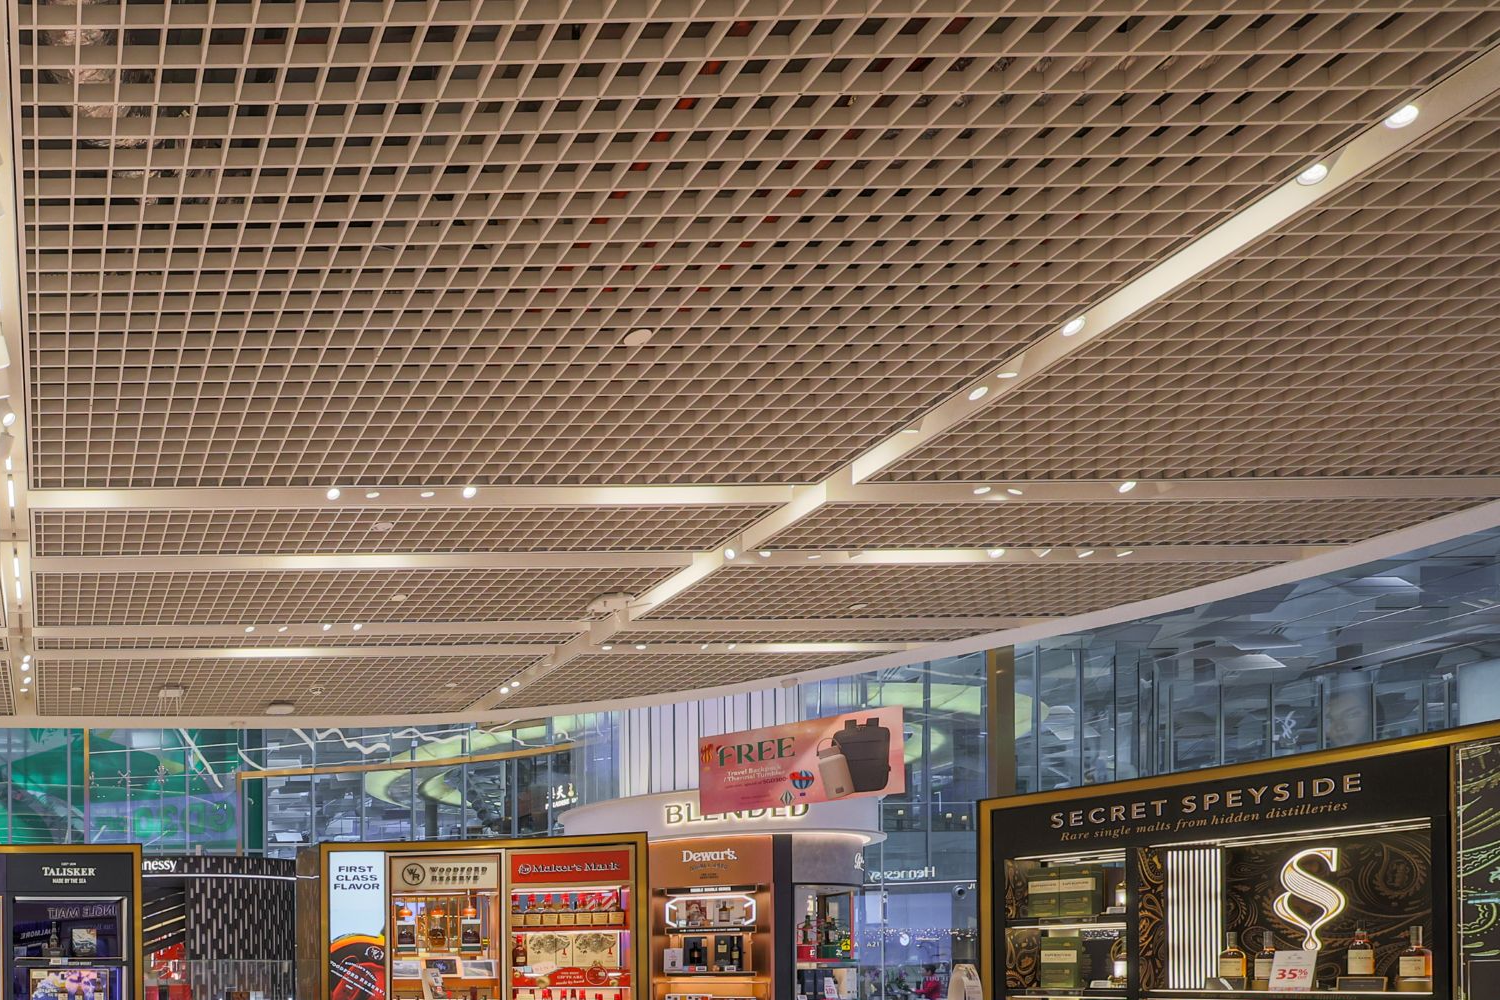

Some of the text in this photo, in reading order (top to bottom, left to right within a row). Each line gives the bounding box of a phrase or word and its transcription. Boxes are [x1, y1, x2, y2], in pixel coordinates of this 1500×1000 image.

[717, 736, 795, 767] FREE
[727, 765, 782, 776] Travel Backpack
[727, 774, 756, 782] Thermal
[1050, 773, 1363, 829] SECRET SPEYSIDE
[1060, 799, 1348, 841] Rare single malts from hidden distilleries
[42, 866, 96, 877] TALISKER
[429, 866, 488, 876] WOODFORD
[532, 862, 620, 873] Maker's Mark
[336, 874, 378, 882] CLASS
[430, 875, 480, 883] RESERVE
[333, 883, 380, 891] FLAVOR
[1276, 968, 1308, 980] 35%
